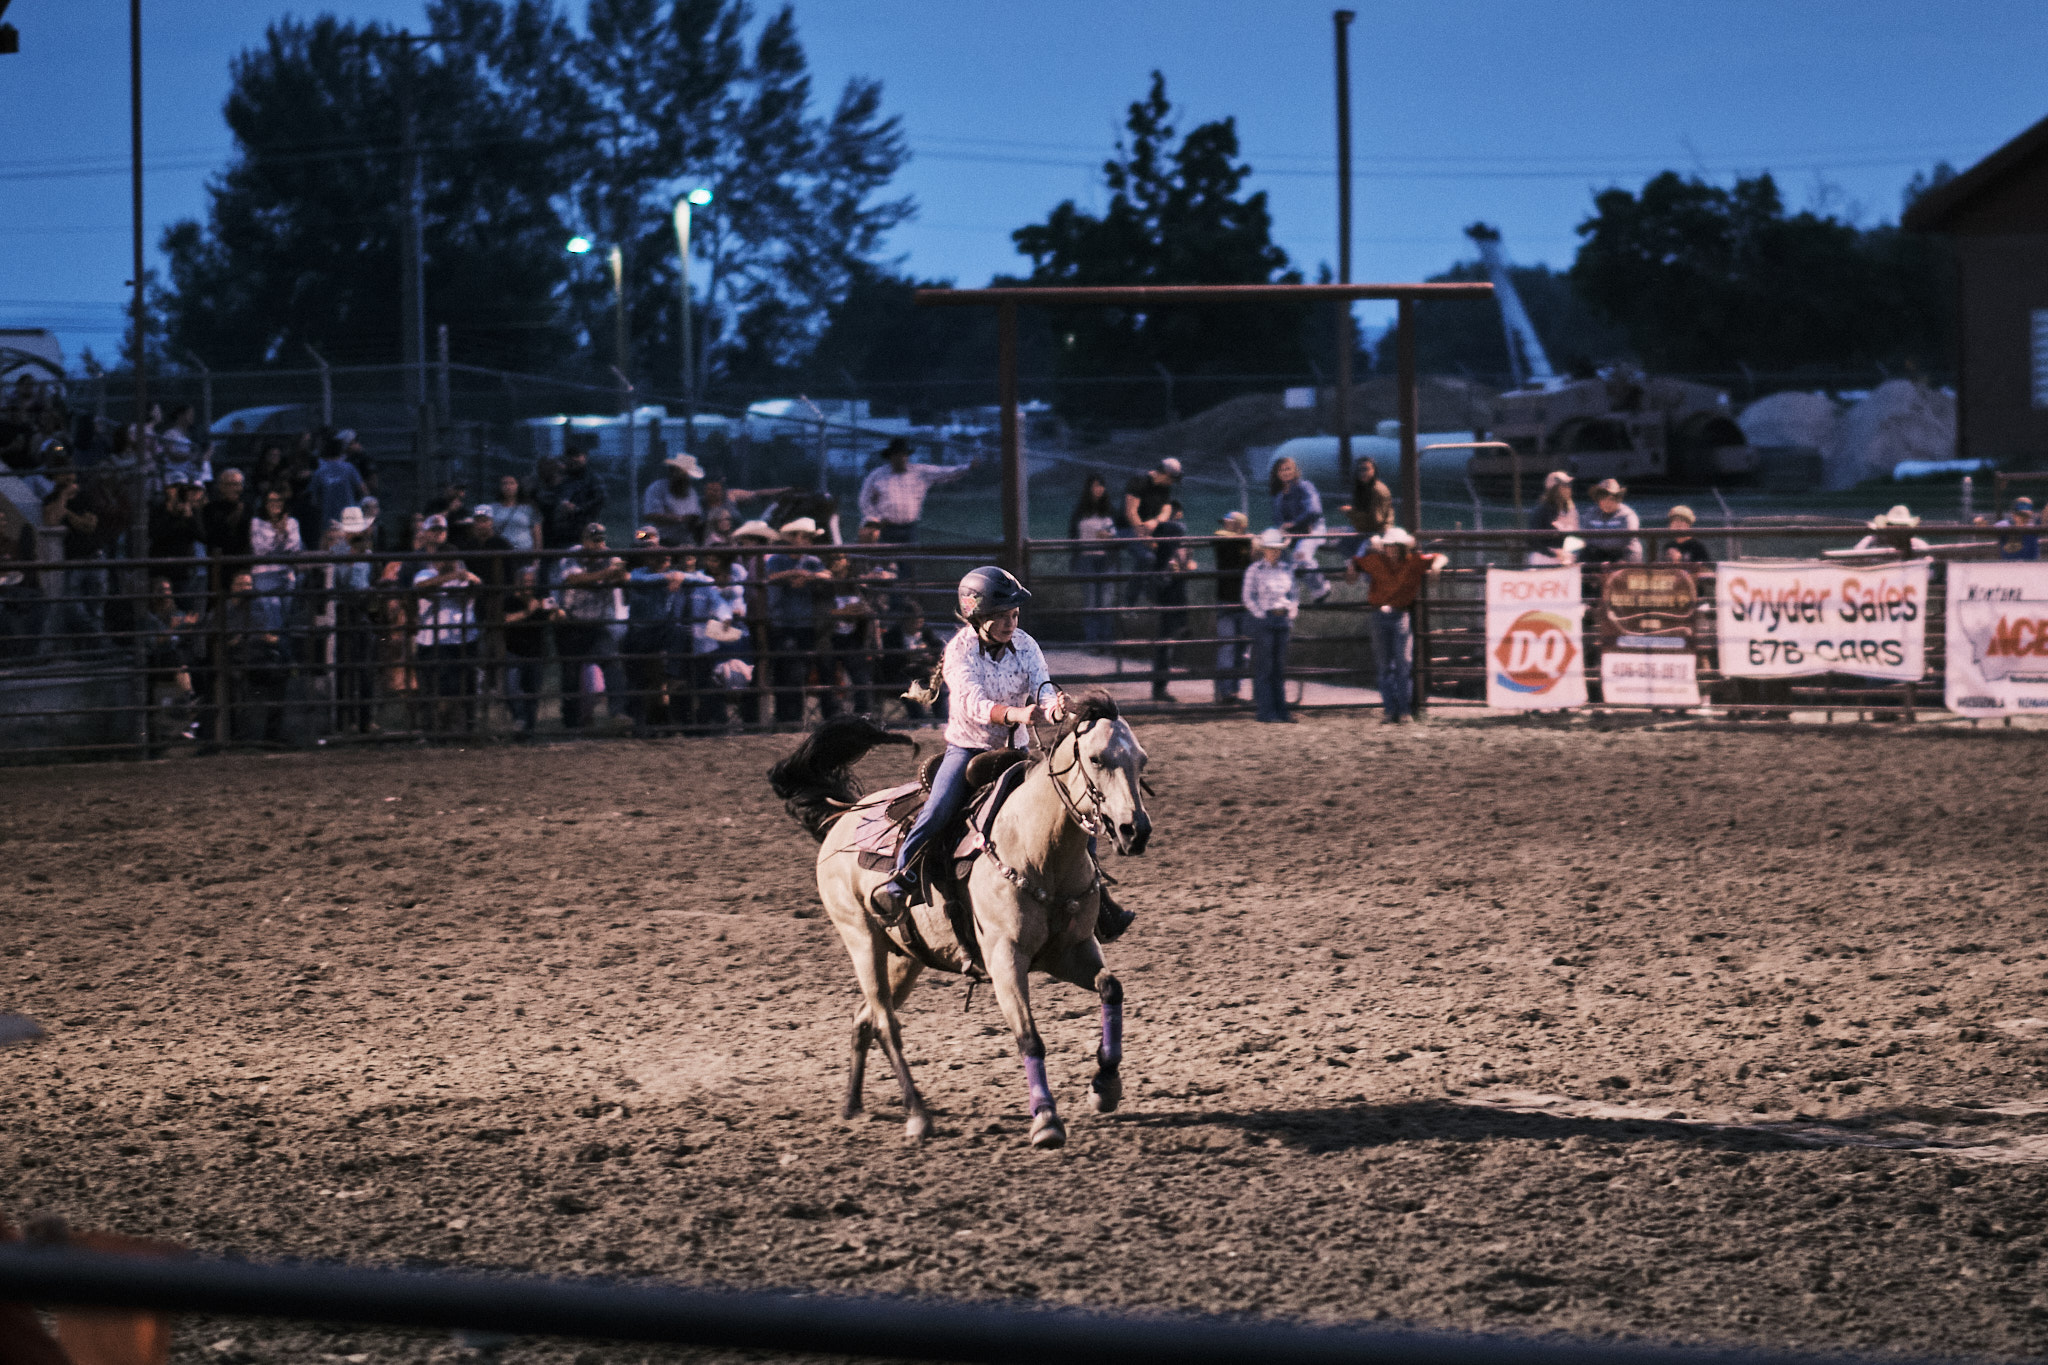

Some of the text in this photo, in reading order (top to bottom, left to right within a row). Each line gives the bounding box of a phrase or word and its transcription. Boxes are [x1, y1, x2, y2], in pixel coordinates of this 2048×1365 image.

[1500, 580, 1569, 600] RONAN
[1728, 576, 1917, 632] Snyder Sales
[1507, 629, 1567, 678] DQ
[1815, 639, 1904, 666] CARS
